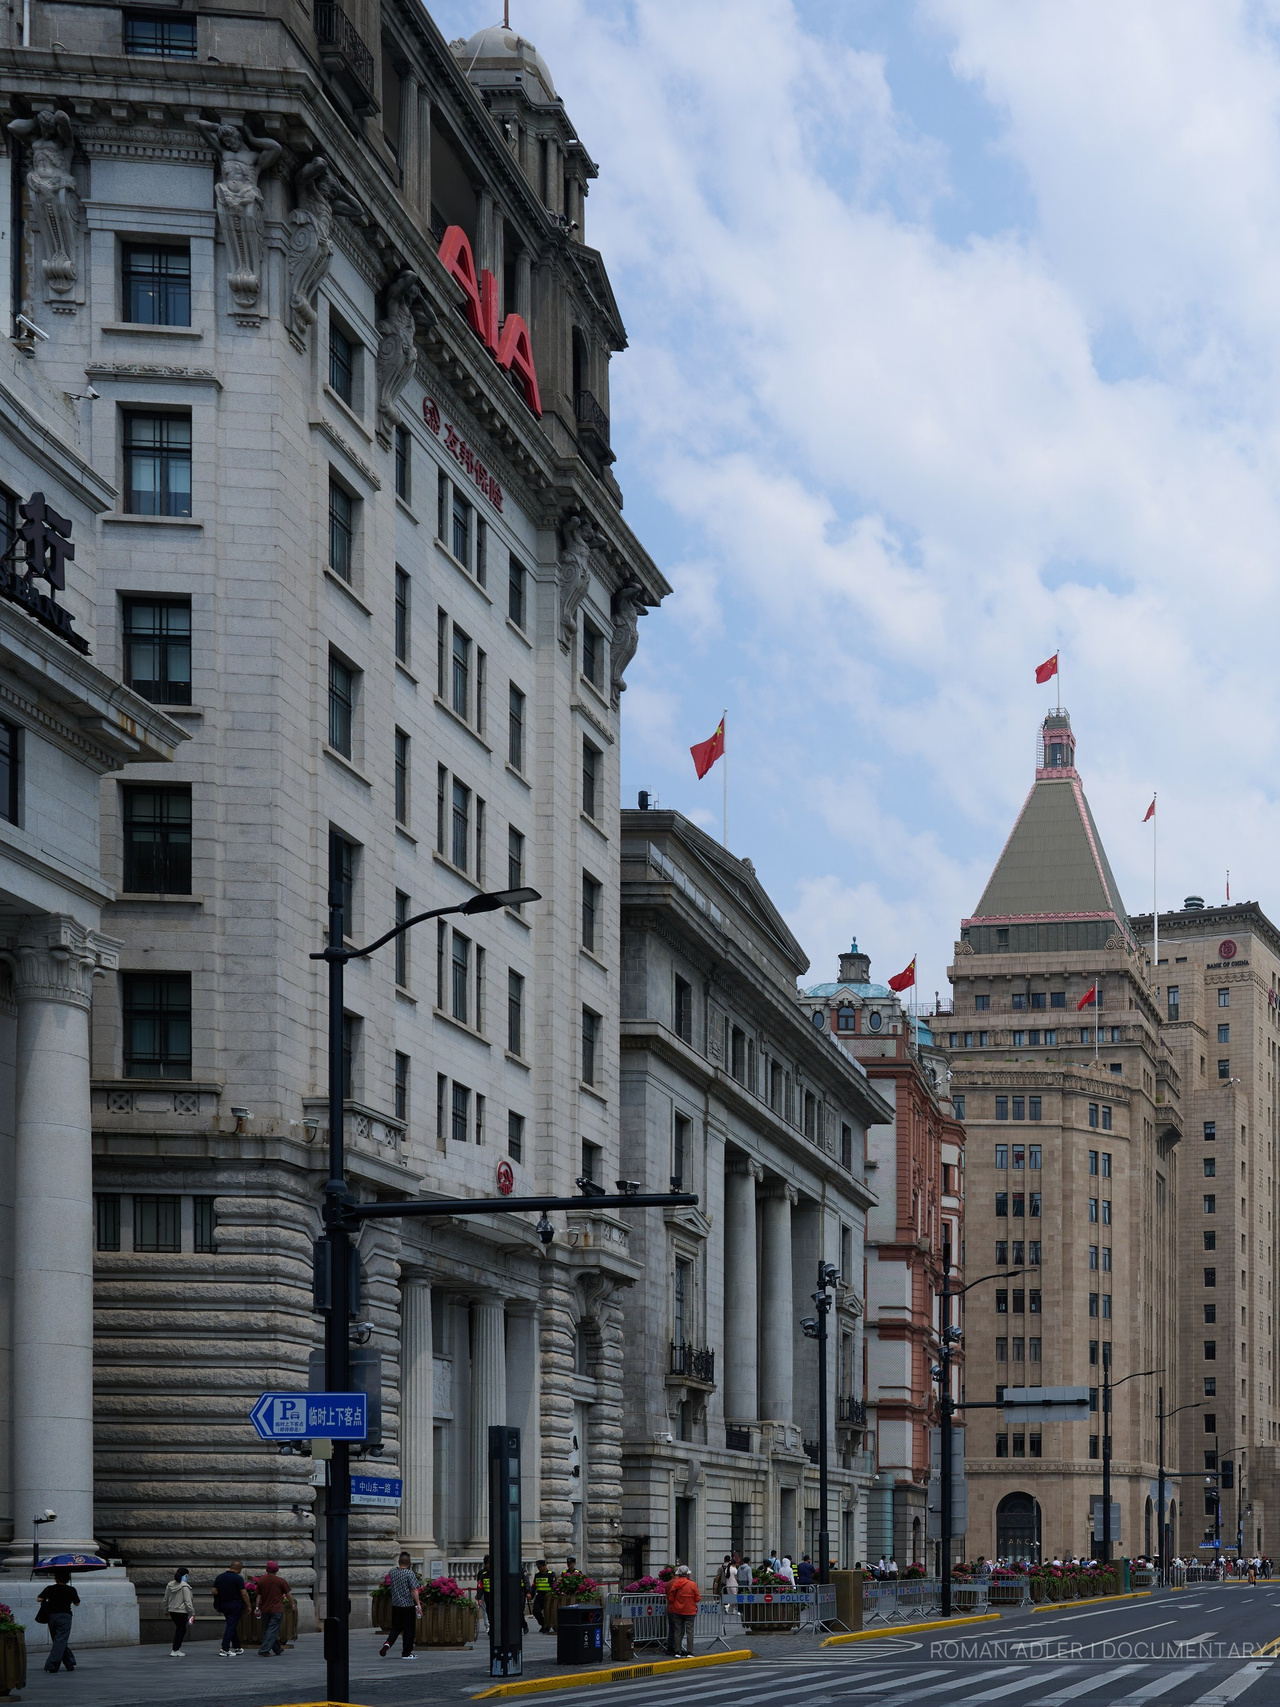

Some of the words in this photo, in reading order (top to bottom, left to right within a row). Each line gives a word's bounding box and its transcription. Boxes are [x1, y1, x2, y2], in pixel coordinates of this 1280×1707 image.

[437, 225, 543, 420] AIA
[444, 423, 503, 513] 友邦保险
[17, 492, 75, 590] 行
[11, 572, 76, 637] BANK
[280, 1401, 296, 1420] P
[308, 1407, 363, 1427] 临时上下客点
[360, 1481, 391, 1494] 中山东一路
[701, 1604, 718, 1614] POLICE
[737, 1595, 755, 1603] 警察
